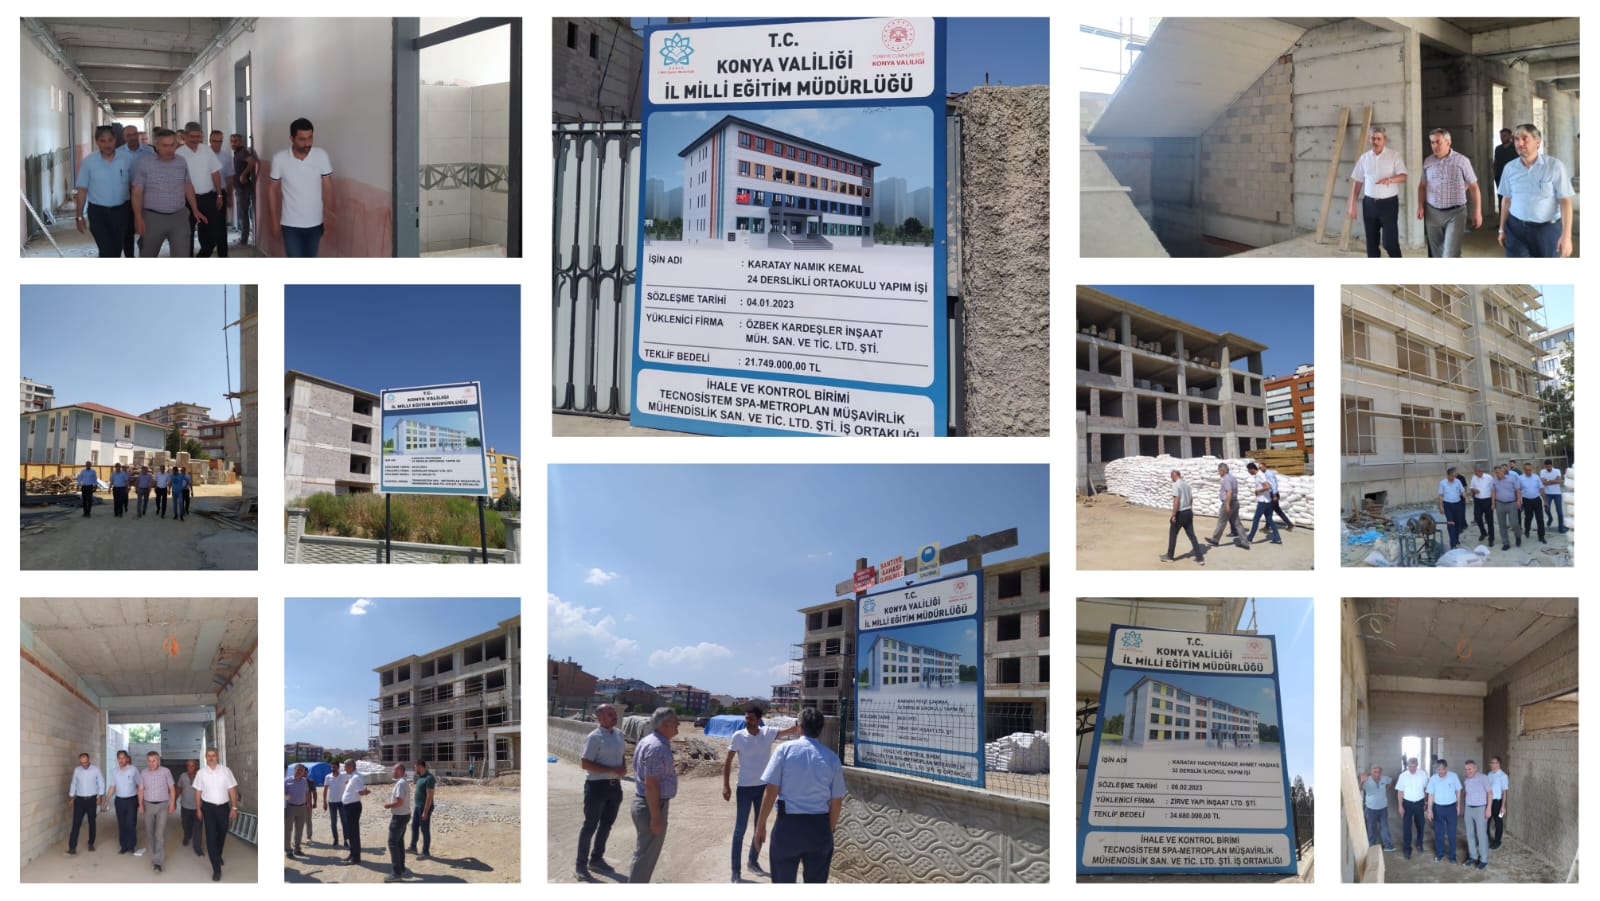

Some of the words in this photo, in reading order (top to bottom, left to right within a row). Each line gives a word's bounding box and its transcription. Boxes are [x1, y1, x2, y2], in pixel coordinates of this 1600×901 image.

[768, 32, 799, 48] T.C.
[717, 56, 774, 74] KONYA
[778, 50, 853, 72] VALİLİĞİ
[665, 82, 680, 100] İL
[684, 80, 728, 99] MİLLİ
[733, 78, 792, 98] EĞİTİM
[797, 73, 913, 96] MÜDÜRLÜĞÜ
[648, 253, 665, 265] İŞİN
[666, 255, 682, 265] ADI
[748, 260, 791, 271] KARATAY
[794, 261, 826, 272] NAMIK
[828, 263, 864, 274] KEMAL
[747, 275, 758, 284] 24
[760, 275, 811, 287] DERSLİKLİ
[813, 278, 877, 291] ORTAOKULU
[879, 281, 912, 293] YAPIM
[914, 281, 928, 294] İŞİ
[647, 292, 695, 304] SÖZLEŞME
[697, 294, 726, 305] TARİHİ
[746, 298, 794, 309] 04.01.2023
[646, 313, 694, 325] YÜKLENİCİ
[695, 316, 724, 327] FİRMA
[746, 318, 779, 330] ÖZBEK
[781, 322, 843, 336] KARDEŞLER
[845, 325, 883, 339] İNŞAAT
[745, 333, 769, 346] MÜH.
[772, 336, 796, 347] SAN.
[797, 337, 811, 347] VE
[814, 337, 832, 350] TİC.
[835, 340, 857, 351] LTD.
[860, 342, 879, 354] ŞTİ.
[644, 348, 675, 360] TEKLİF
[677, 351, 710, 363] BEDELİ
[744, 358, 807, 372] 21.749.000,00
[809, 362, 821, 373] TL
[707, 378, 737, 393] İHALE
[741, 383, 755, 394] VE
[758, 384, 811, 400] KONTROL
[815, 388, 850, 404] BİRİMİ
[659, 389, 733, 406] TECNOSİSTEM
[735, 397, 829, 418] SPA-METROPLAN
[833, 406, 905, 425] MÜŞAVİRLİK
[648, 402, 718, 420] MÜHENDİSLİK
[720, 409, 745, 422] SAN.
[748, 413, 763, 425] VE
[766, 412, 786, 428] TİC.
[789, 417, 813, 429] LTD.
[816, 419, 838, 433] ŞTİ.
[839, 422, 851, 436] İŞ
[905, 592, 917, 600] T.C.
[884, 605, 907, 614] KONYA
[908, 596, 941, 610] VALİLİĞİ
[872, 618, 889, 627] MİLLİ
[916, 604, 968, 620] MÜDÜRLÜĞÜ
[1186, 638, 1204, 646] T.C.
[1156, 648, 1190, 657] KONYA
[1192, 649, 1232, 659] VALİLİĞİ
[1123, 654, 1132, 664] İL
[1136, 656, 1163, 667] MİLLİ
[1166, 658, 1200, 669] EĞİTİM
[1202, 661, 1264, 672] MÜDÜRLÜĞÜ
[1098, 782, 1134, 790] SÖZLEŞME
[1141, 834, 1164, 843] İHALE
[1216, 835, 1240, 844] BİRİMİ
[1103, 845, 1159, 854] TECNOSİSTEM
[1229, 845, 1274, 855] MÜŞAVİRLİK
[1092, 856, 1149, 865] MÜHENDİSLİK
[1184, 856, 1197, 865] TİC.
[1218, 857, 1232, 866] ŞTİ.
[1234, 857, 1241, 866] İŞ
[1243, 856, 1282, 865] ORTAKLIĞI
